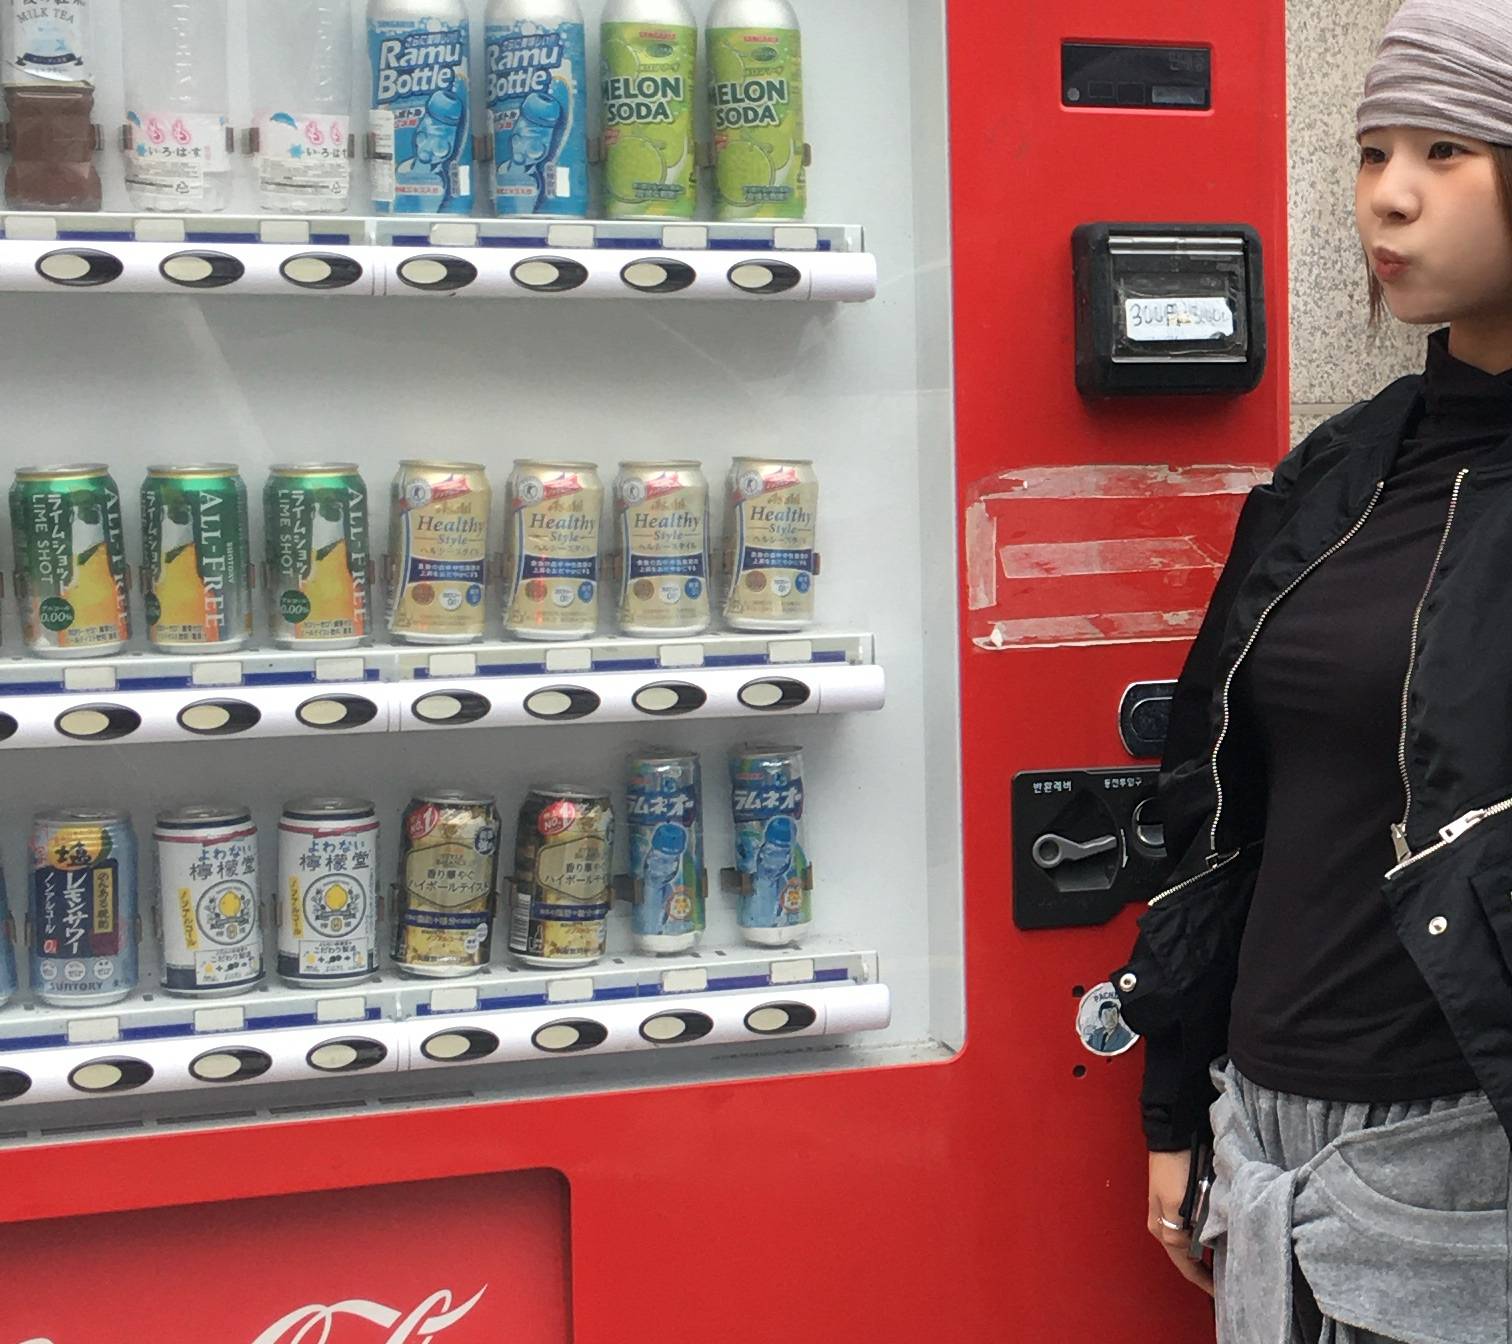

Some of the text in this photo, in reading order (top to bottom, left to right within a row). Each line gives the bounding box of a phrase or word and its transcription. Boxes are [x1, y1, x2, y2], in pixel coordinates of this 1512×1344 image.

[17, 7, 75, 24] MILK TEA
[380, 39, 461, 70] Ramu
[488, 44, 560, 72] Ramu
[378, 64, 452, 101] Bottle
[487, 67, 548, 103] Bottle
[607, 101, 670, 124] SODA
[716, 104, 777, 128] SODA
[416, 514, 486, 538] Healthy
[529, 512, 597, 535] Healthy
[634, 512, 700, 533] Healthy
[750, 505, 813, 528] Healthy
[32, 493, 54, 585] LIME SHOT
[278, 488, 294, 578] LIME SHOT
[549, 530, 580, 545] Style
[653, 530, 684, 544] Style
[768, 523, 798, 536] Style
[47, 493, 69, 596] ライムショット
[436, 534, 468, 549] Style
[199, 490, 226, 628] ALL-FREE
[347, 486, 366, 622] ALL-FREE
[1032, 777, 1142, 794] 반환레버 동전투입구
[54, 841, 93, 868] 塩
[197, 845, 253, 862] よわない
[308, 839, 366, 854] よわない
[189, 855, 257, 882] 檸檬堂
[299, 851, 371, 873] 檸檬堂
[407, 879, 490, 894] ハイボールテイスト
[43, 871, 57, 935] ノンアルコール
[62, 872, 89, 955] レモンサワー
[49, 980, 103, 992] SUNTORY
